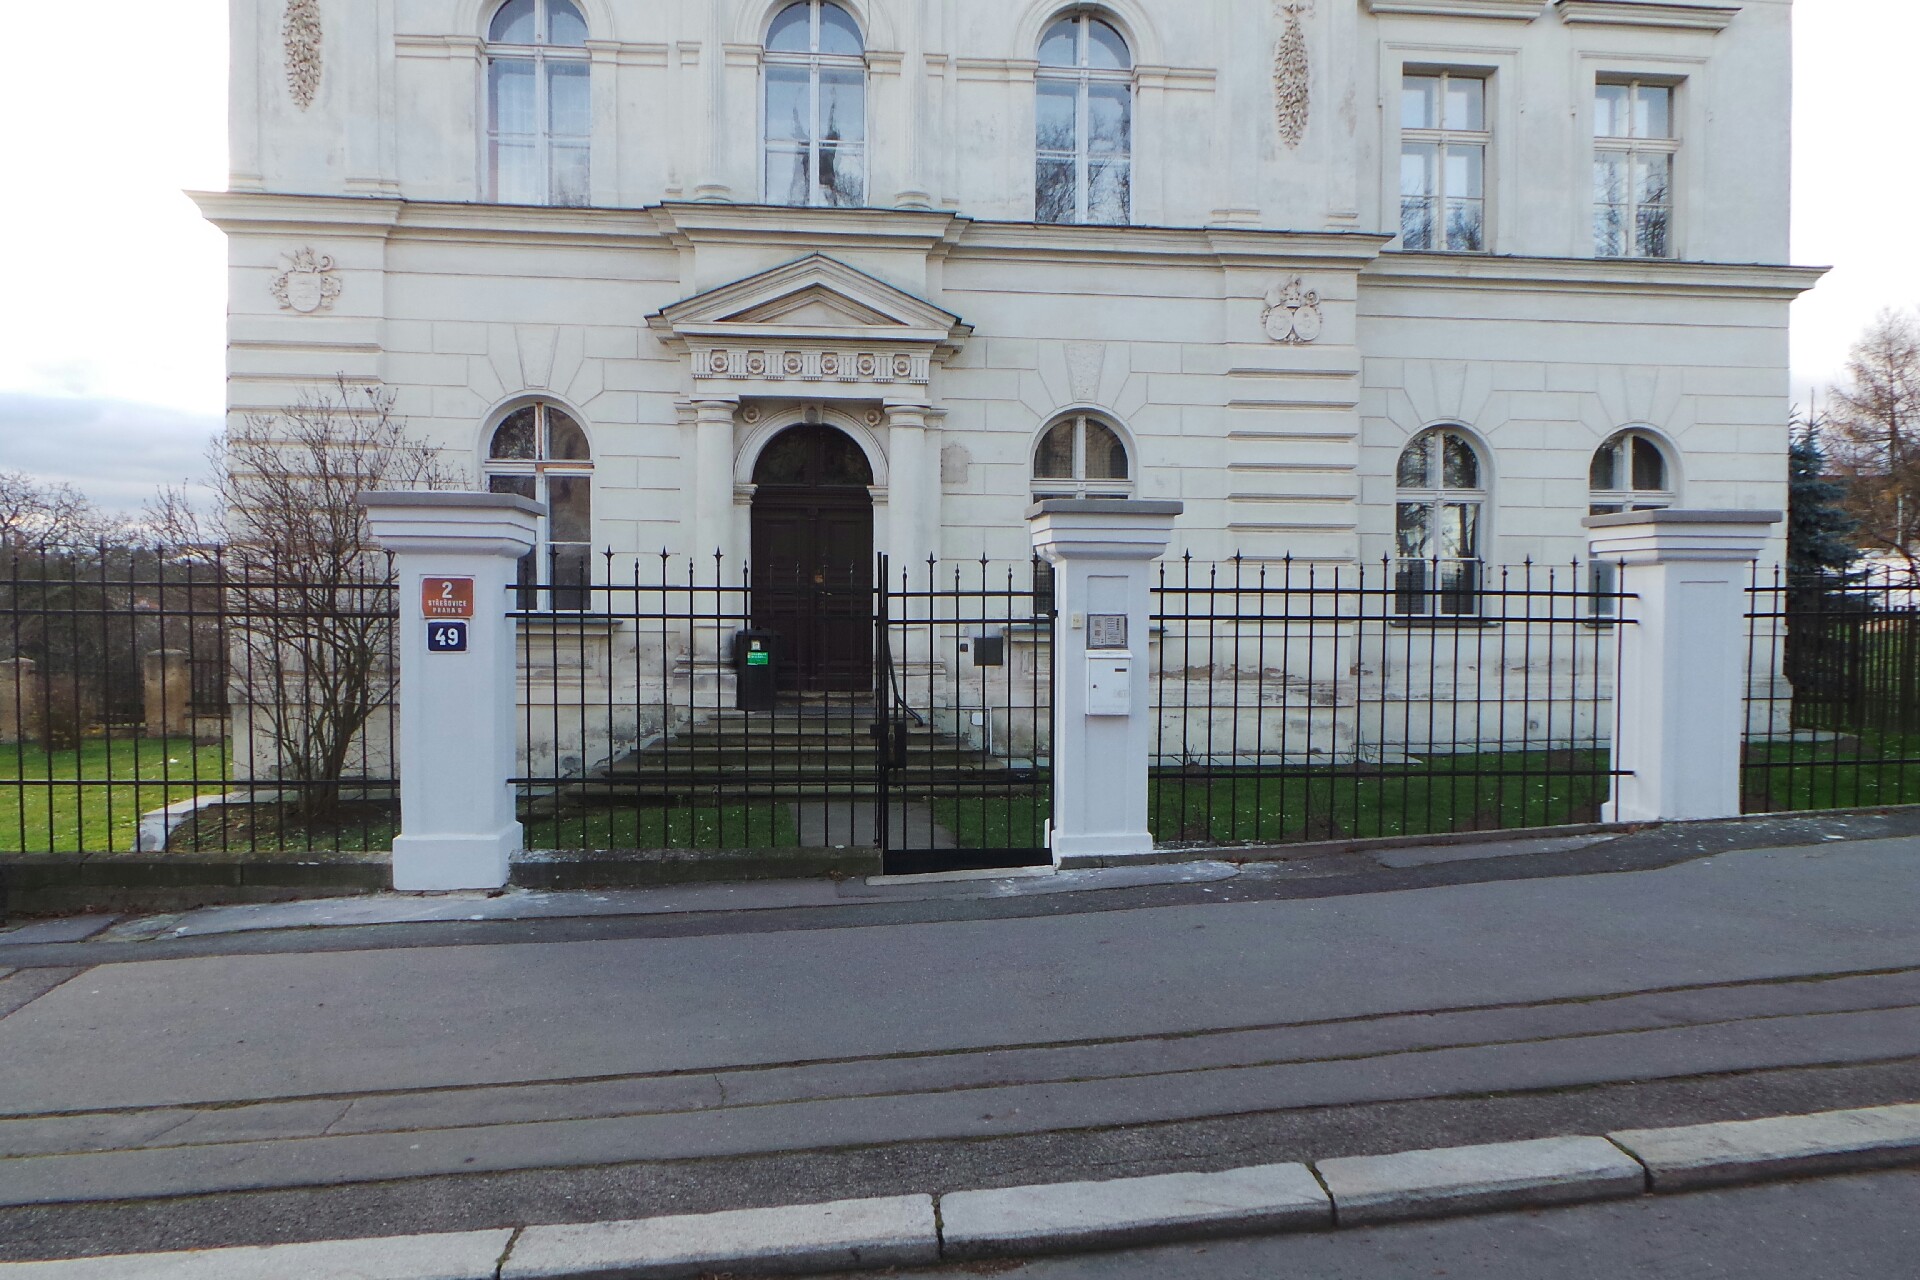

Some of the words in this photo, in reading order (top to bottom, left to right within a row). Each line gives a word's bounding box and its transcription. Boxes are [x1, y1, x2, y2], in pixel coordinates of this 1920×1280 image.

[442, 581, 453, 598] 2
[428, 599, 467, 607] STŘEŠOVICE
[435, 628, 458, 646] 49
